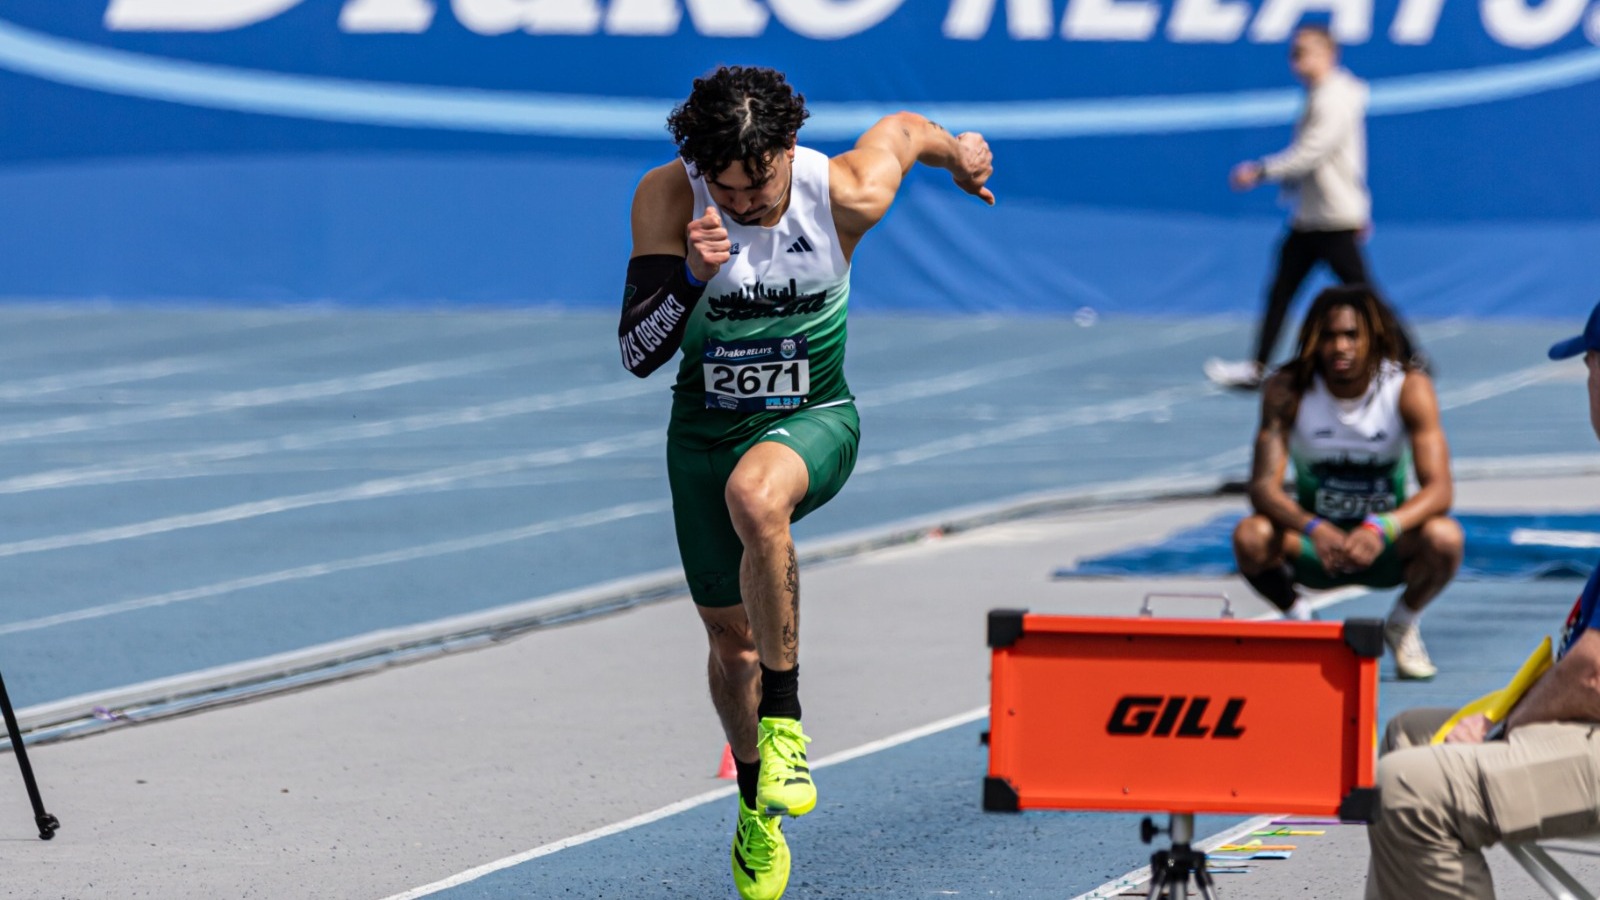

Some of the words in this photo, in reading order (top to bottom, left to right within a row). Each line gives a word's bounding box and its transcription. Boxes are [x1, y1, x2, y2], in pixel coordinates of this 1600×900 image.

[634, 293, 686, 353] CHICAGO
[715, 347, 746, 358] Drake
[746, 347, 773, 356] RELAYS
[712, 362, 800, 395] 2671
[1105, 695, 1247, 739] GILL
